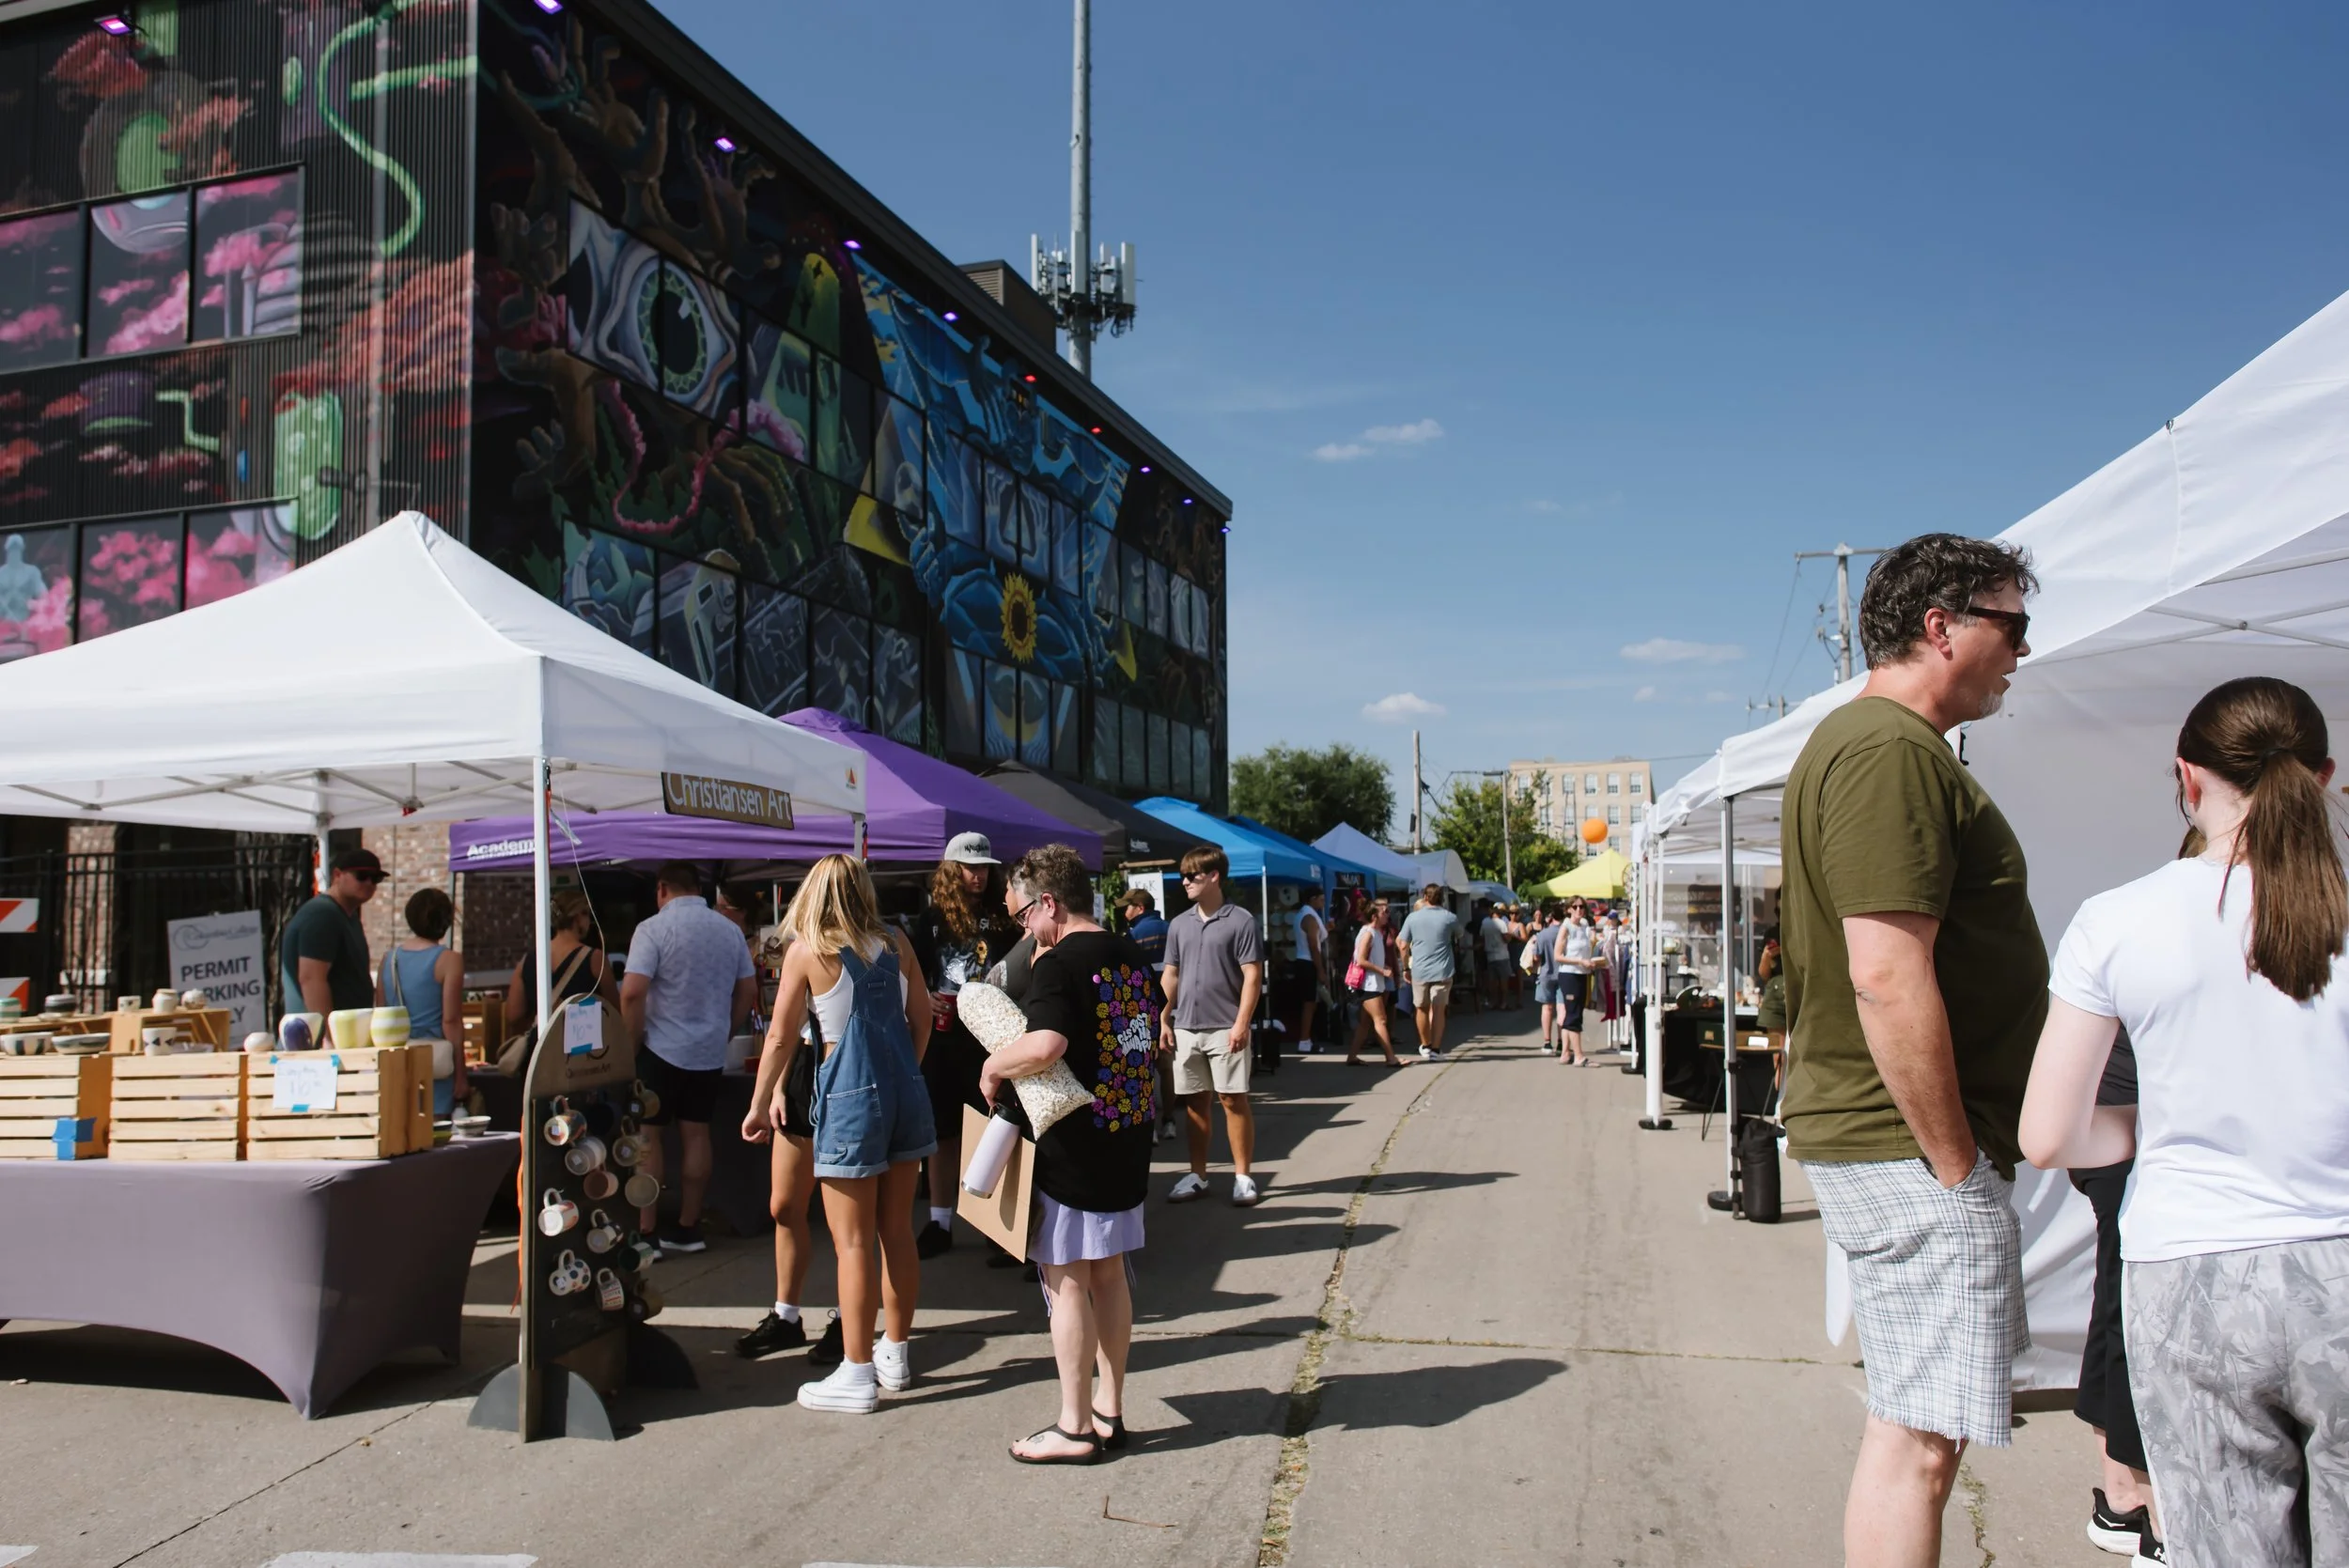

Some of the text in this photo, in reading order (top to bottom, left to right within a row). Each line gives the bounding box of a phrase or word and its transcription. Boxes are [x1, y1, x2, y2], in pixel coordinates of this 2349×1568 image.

[666, 772, 792, 821] Christiansen Art
[466, 839, 535, 856] Academ
[180, 956, 251, 982] PERMIT
[179, 979, 260, 1002] RKING
